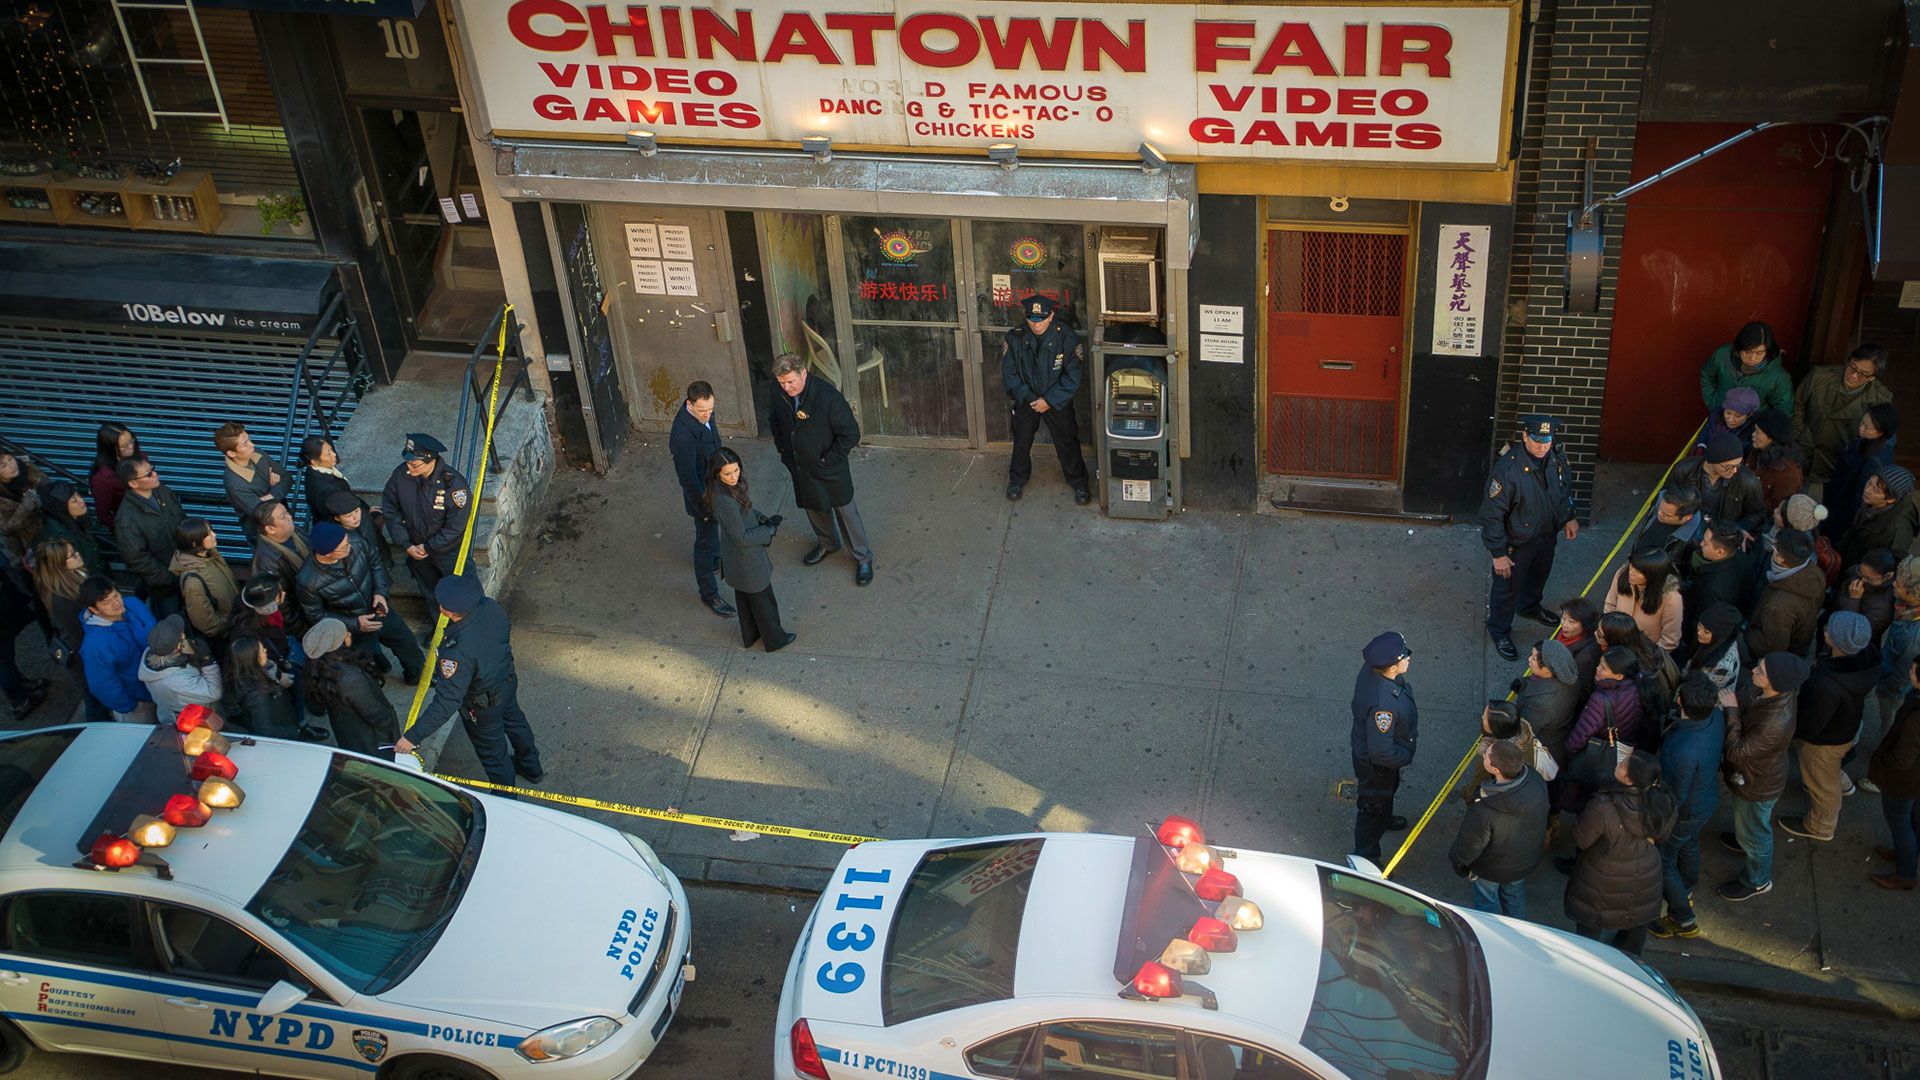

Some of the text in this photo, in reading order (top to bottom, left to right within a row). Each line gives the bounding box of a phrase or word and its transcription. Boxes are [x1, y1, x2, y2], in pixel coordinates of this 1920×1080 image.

[377, 19, 420, 59] 10
[507, 0, 1453, 78] CHINATOWN FAIR
[538, 62, 738, 96] VIDEO
[968, 82, 1108, 101] FAMOUS
[532, 94, 762, 129] GAMES
[938, 101, 955, 118] &
[1209, 84, 1429, 116] VIDEO
[915, 121, 1035, 139] CHICKENS
[1189, 117, 1443, 150] GAMES
[122, 303, 300, 330] 10Below ice cream
[606, 909, 637, 961] NYPD
[620, 907, 659, 981] POLICE
[816, 868, 891, 994] 1139
[38, 993, 137, 1016] PROFESSIONALISM
[40, 982, 96, 999] COURTESY
[37, 1003, 86, 1018] RESPECT
[209, 1008, 334, 1050] NYPD
[430, 1024, 497, 1047] POLICE
[843, 1051, 859, 1067] 11
